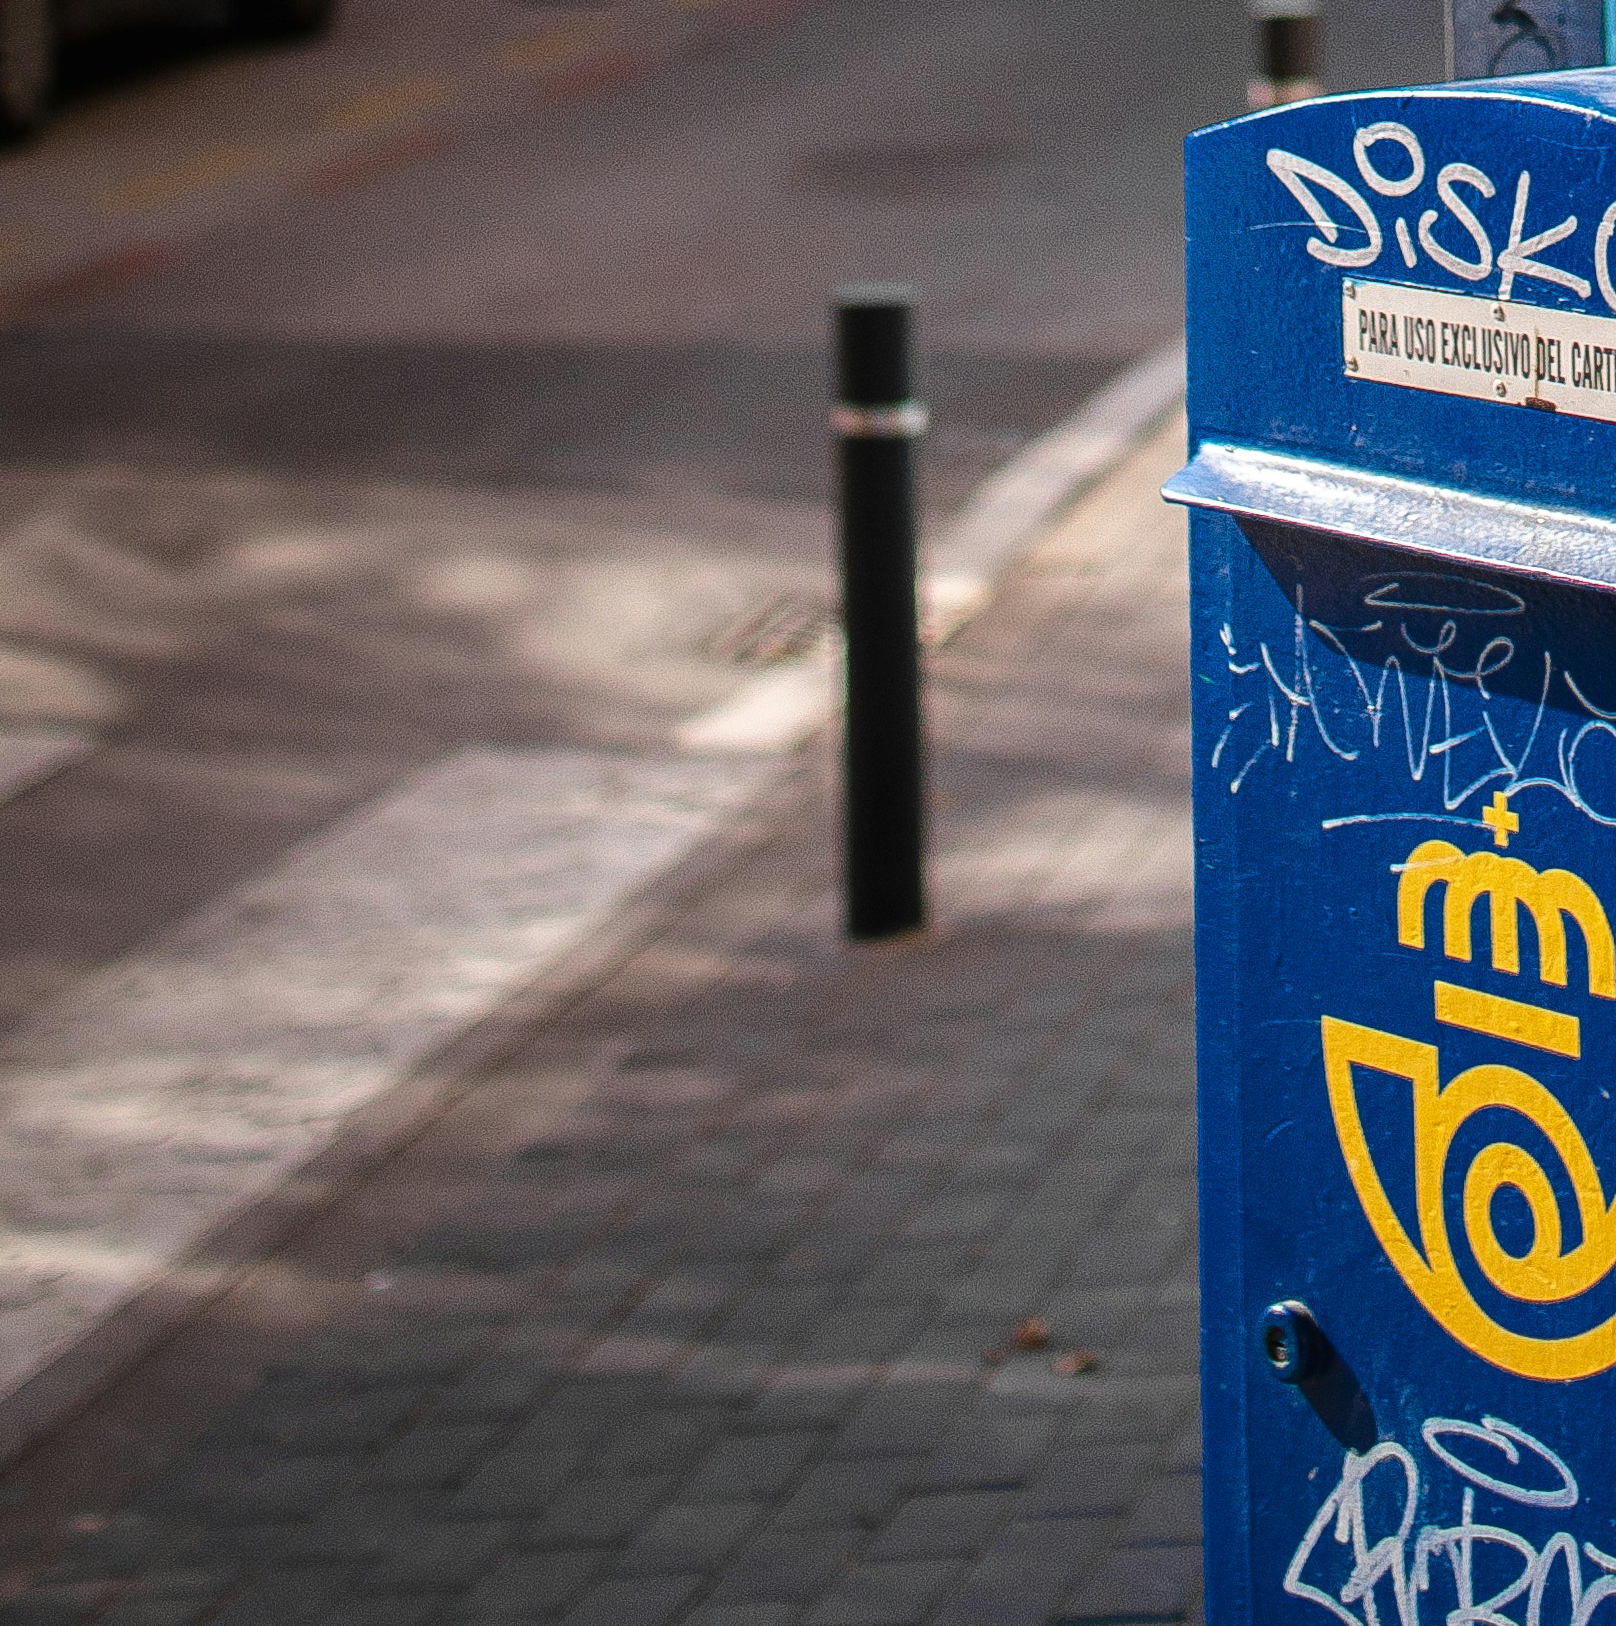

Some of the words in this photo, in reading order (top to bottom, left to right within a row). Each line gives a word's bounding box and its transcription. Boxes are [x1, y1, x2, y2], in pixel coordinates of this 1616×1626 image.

[1358, 308, 1399, 354] PARA
[1404, 315, 1436, 365] USO
[1440, 321, 1531, 379] EXCLUSIVO
[1536, 335, 1566, 384] DEL
